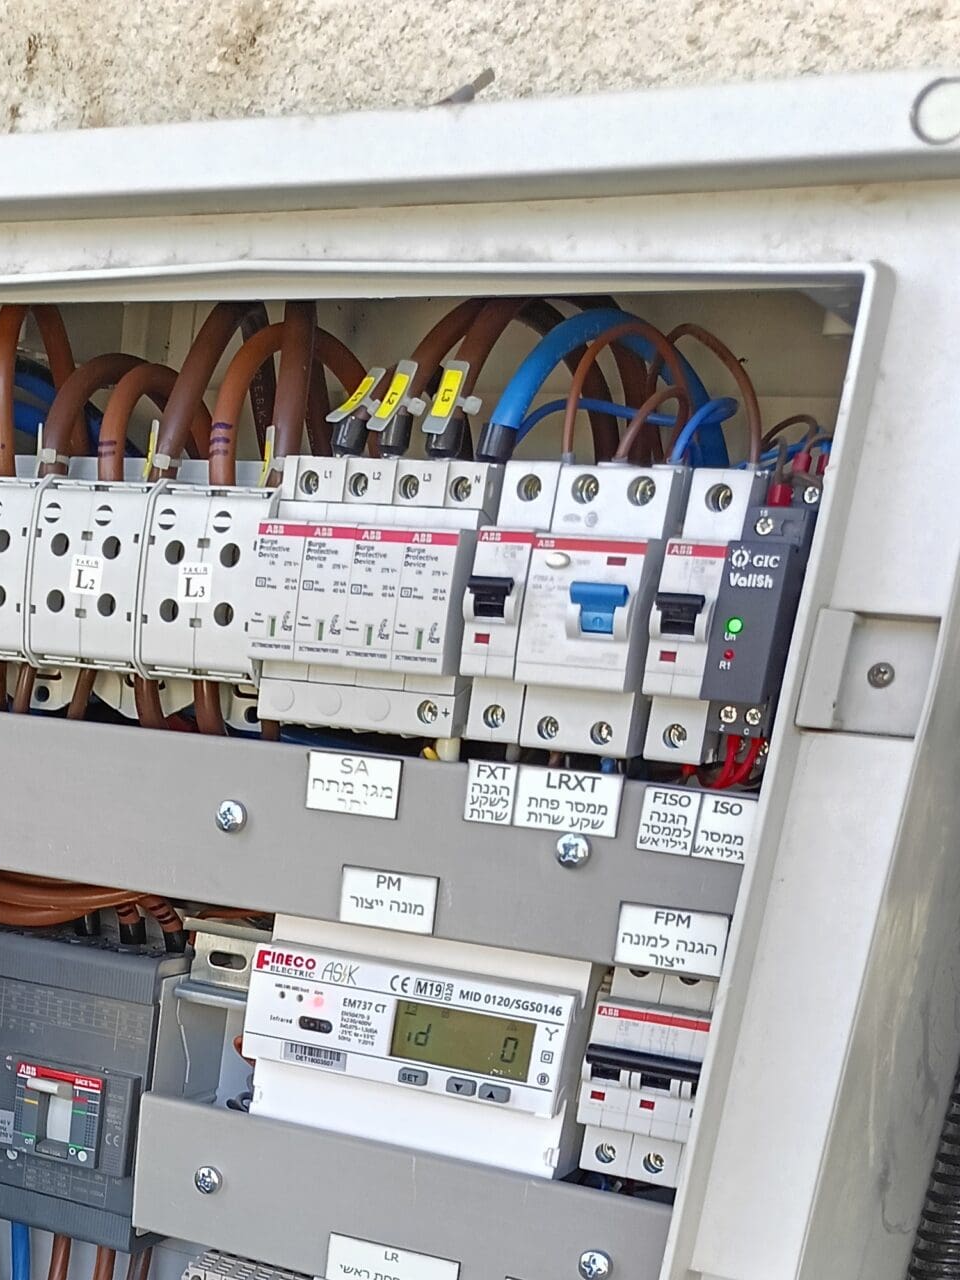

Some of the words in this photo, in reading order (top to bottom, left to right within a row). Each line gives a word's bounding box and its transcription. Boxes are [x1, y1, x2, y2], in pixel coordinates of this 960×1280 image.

[441, 388, 453, 403] L3
[266, 525, 284, 534] ABB
[314, 528, 333, 536] ABB
[362, 531, 381, 540] ABB
[481, 532, 501, 541] ABB
[412, 533, 432, 543] ABB
[537, 539, 555, 547] ABB
[671, 545, 693, 555] ABB
[753, 555, 780, 568] GIC
[76, 569, 95, 590] L2
[184, 577, 205, 598] L3
[340, 757, 369, 776] SA
[477, 764, 511, 780] FXT
[312, 778, 354, 794] מתח
[471, 783, 510, 796] הגנה
[546, 772, 601, 793] LRXT
[469, 795, 509, 808] לשקע
[527, 797, 560, 810] פחת
[653, 792, 691, 808] FISO
[469, 808, 507, 821] שרות
[565, 800, 608, 816] ממסר
[712, 800, 743, 816] ISO
[526, 811, 564, 826] שרות
[568, 817, 604, 831] שקע
[649, 811, 688, 826] הגנה
[642, 823, 692, 838] לממסר
[701, 830, 744, 846] ממסר
[376, 874, 401, 891] PM
[350, 895, 384, 909] ייצור
[390, 900, 424, 916] מונה
[654, 911, 691, 928] FPM
[621, 931, 671, 949] למונה
[676, 939, 717, 956] הגנה
[256, 949, 316, 970] FINECO
[649, 953, 685, 967] ייצור
[270, 965, 315, 979] ELECTRIC
[342, 997, 373, 1010] EM737
[374, 1003, 387, 1013] CT
[415, 981, 443, 997] M19
[459, 989, 482, 1002] MID
[484, 995, 563, 1017] 0120/SGS0146
[600, 1007, 619, 1016] ABB
[19, 1064, 36, 1076] ABB
[401, 1073, 419, 1083] SET
[384, 1251, 399, 1263] LR
[339, 1262, 370, 1280] ראשי
